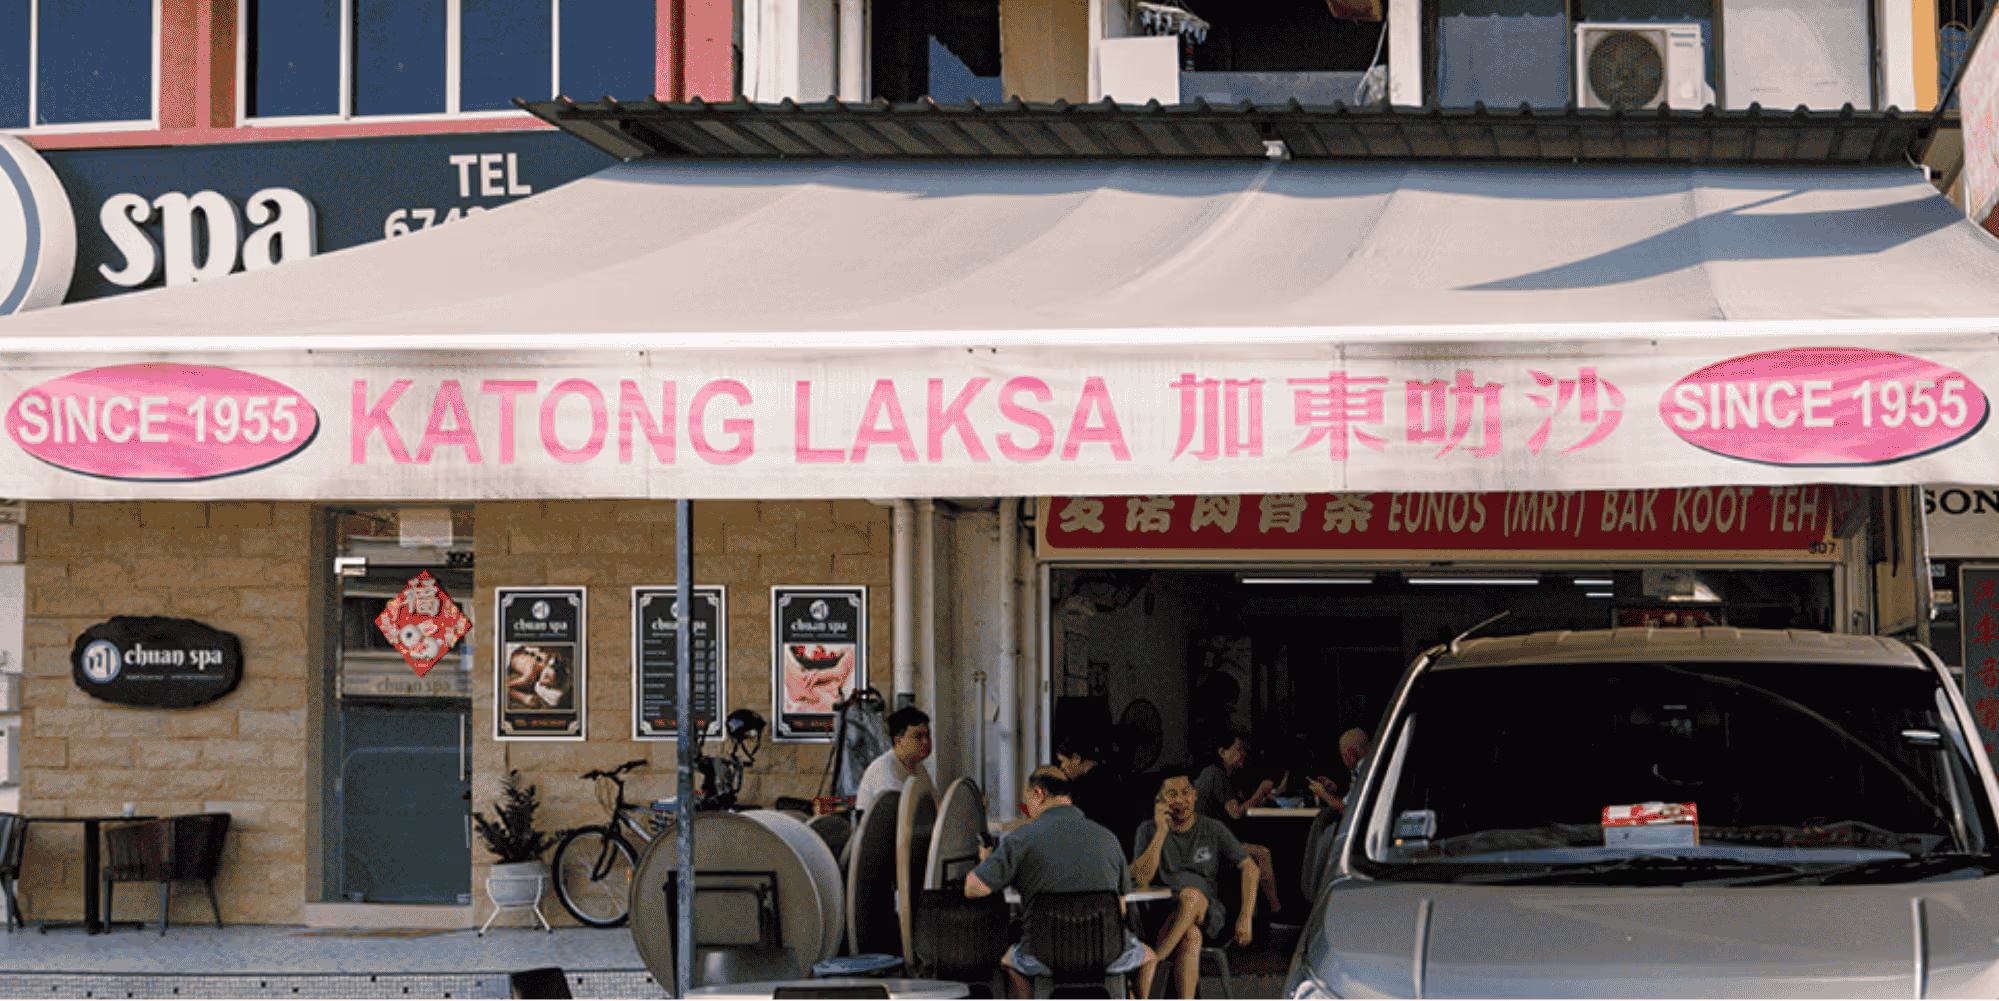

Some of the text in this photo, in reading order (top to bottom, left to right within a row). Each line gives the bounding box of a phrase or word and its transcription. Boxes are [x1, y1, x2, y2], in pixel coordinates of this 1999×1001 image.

[450, 153, 532, 197] TEL
[98, 187, 314, 288] spa
[18, 396, 299, 444] SINCE 1955
[350, 375, 1132, 466] KATONG LAKSA
[1169, 366, 1626, 463] 加東叻沙
[1672, 380, 1968, 432] SINCE 1955
[1388, 486, 1820, 537] EUNOS (MRT) BAK KOOT TEH
[403, 578, 440, 617] 福
[123, 643, 223, 671] chuan spa
